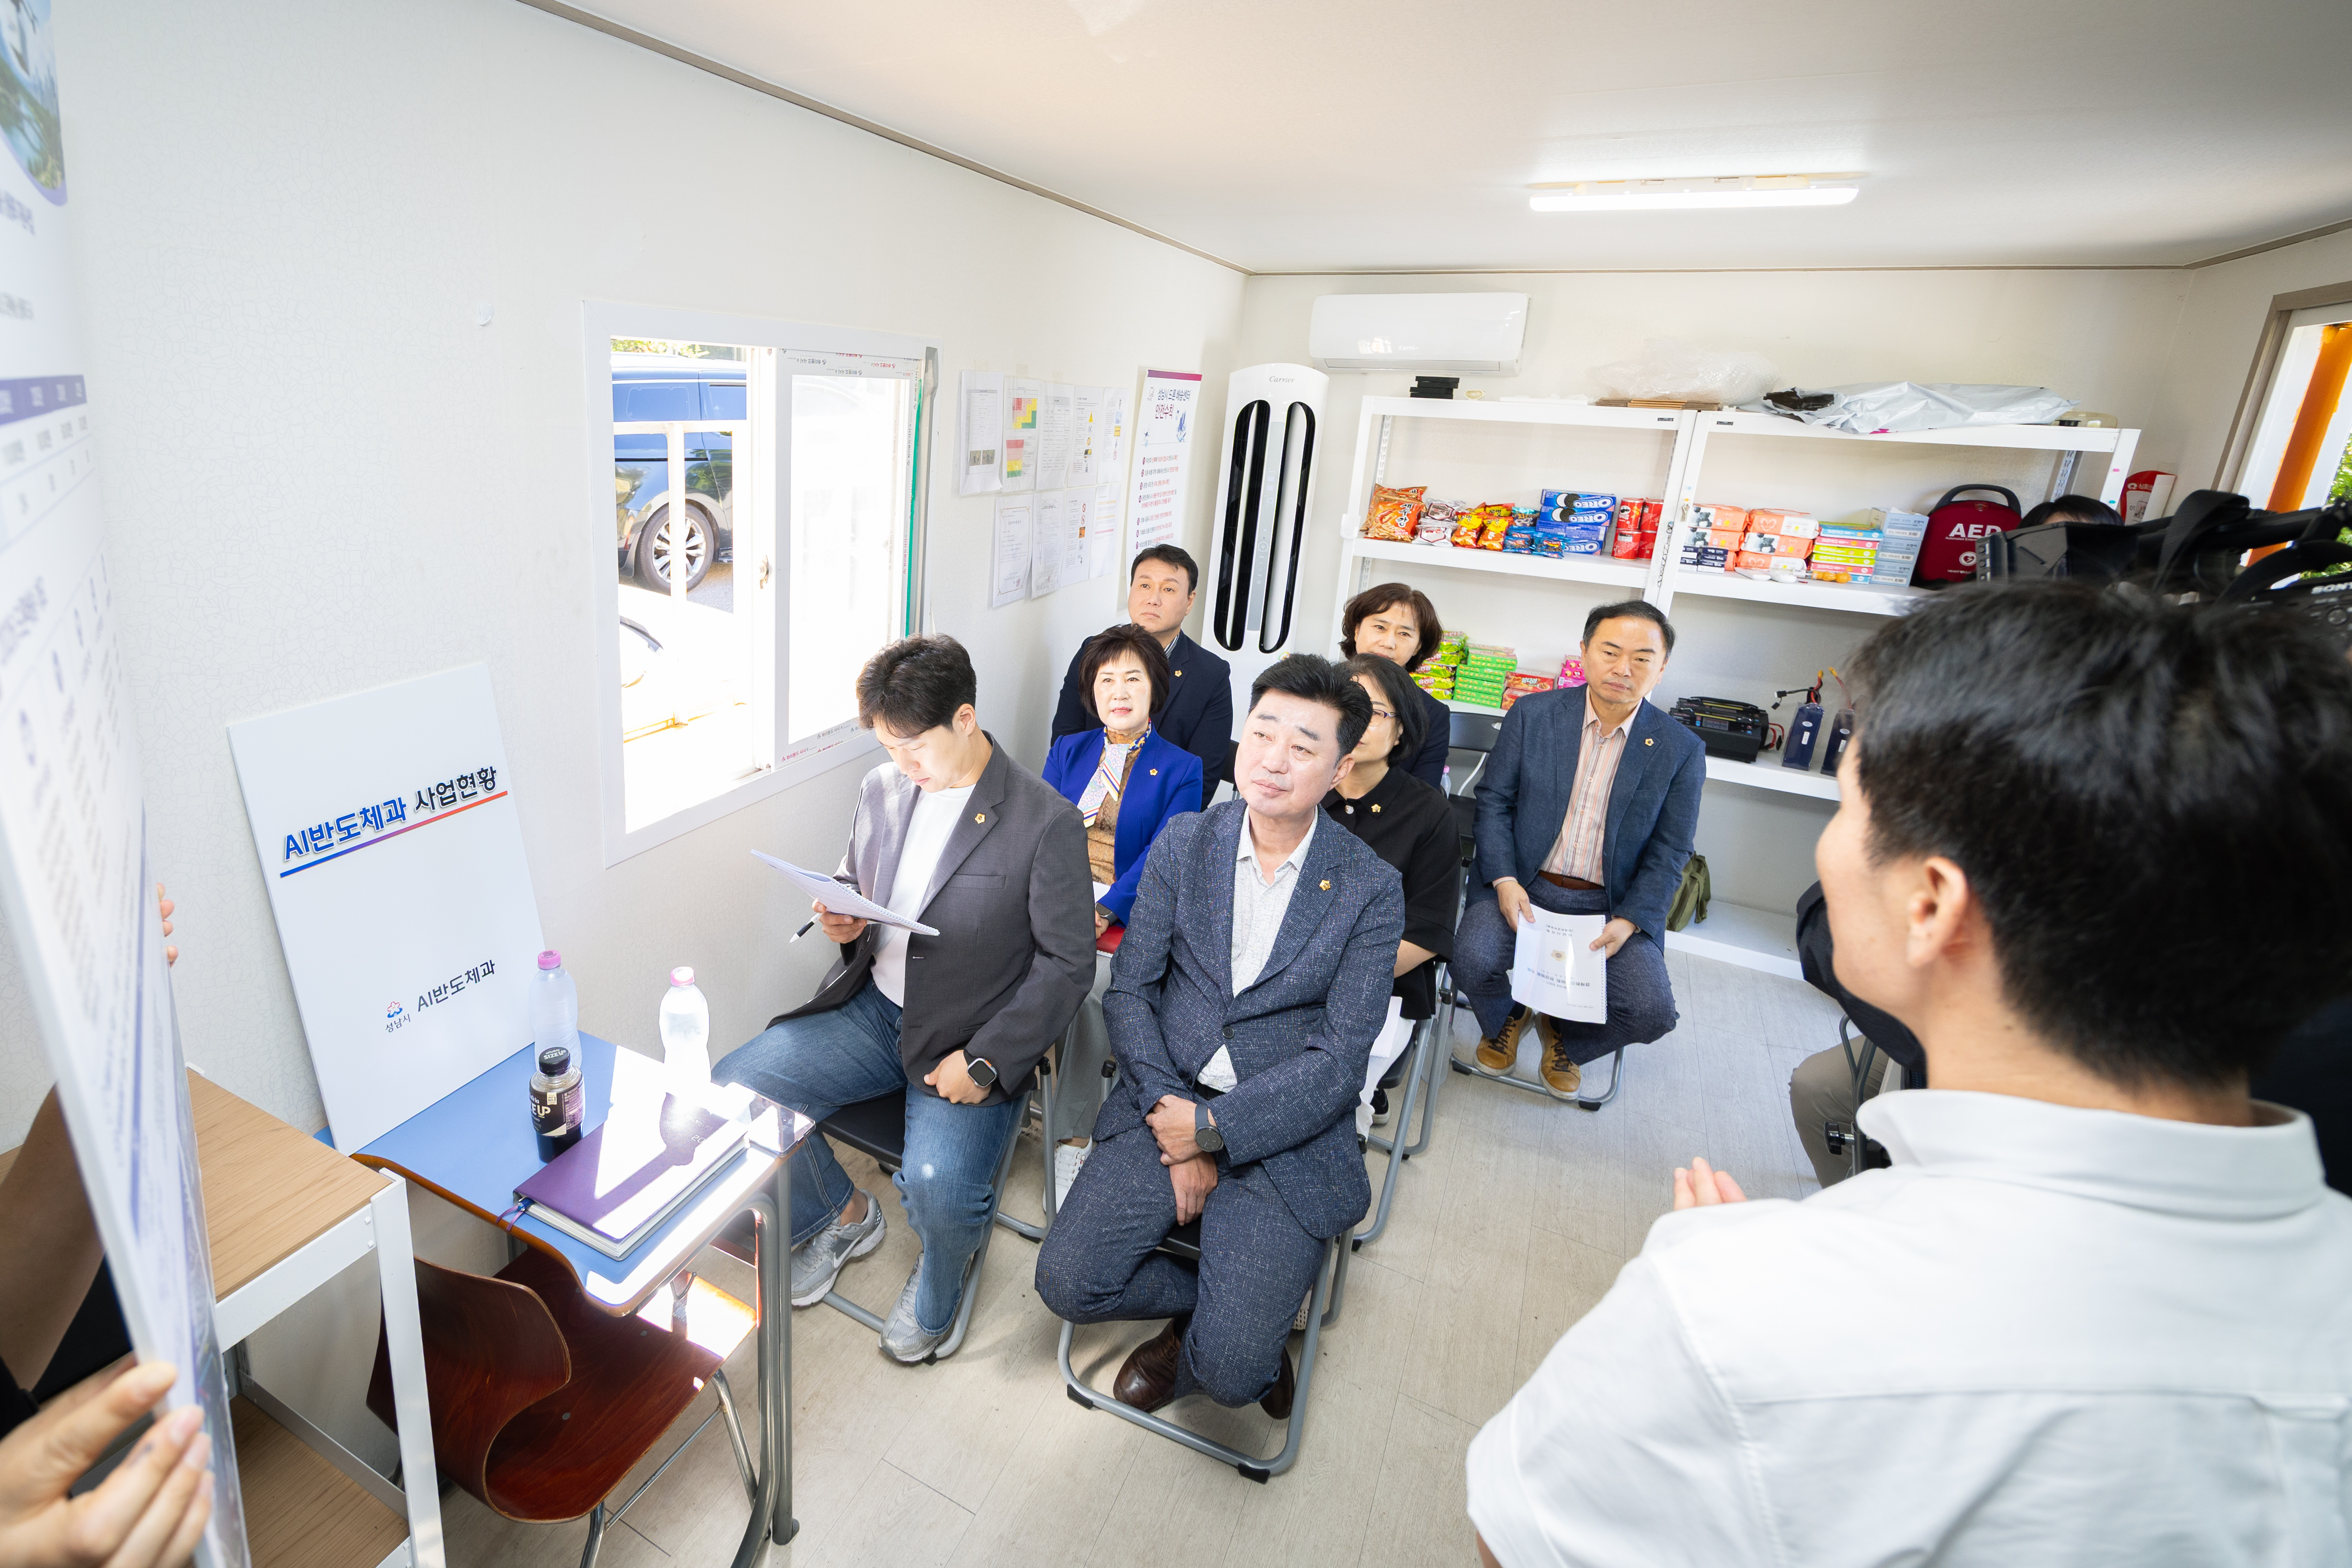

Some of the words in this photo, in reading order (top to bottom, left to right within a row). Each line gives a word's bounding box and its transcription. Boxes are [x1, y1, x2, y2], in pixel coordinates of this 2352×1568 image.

[1168, 389, 1176, 401] 드론
[1155, 404, 1174, 419] 안전수칙
[1575, 498, 1612, 509] OREO
[1396, 503, 1412, 527] 새우깡
[1570, 512, 1607, 523] OREO
[1948, 523, 2002, 538] AED
[284, 797, 408, 861] AI반도체과
[414, 766, 497, 813] 사업현황
[418, 959, 495, 1013] AI반도체과
[385, 1013, 411, 1033] 성남시
[543, 1051, 559, 1060] SIZE
[691, 1134, 705, 1143] 20
